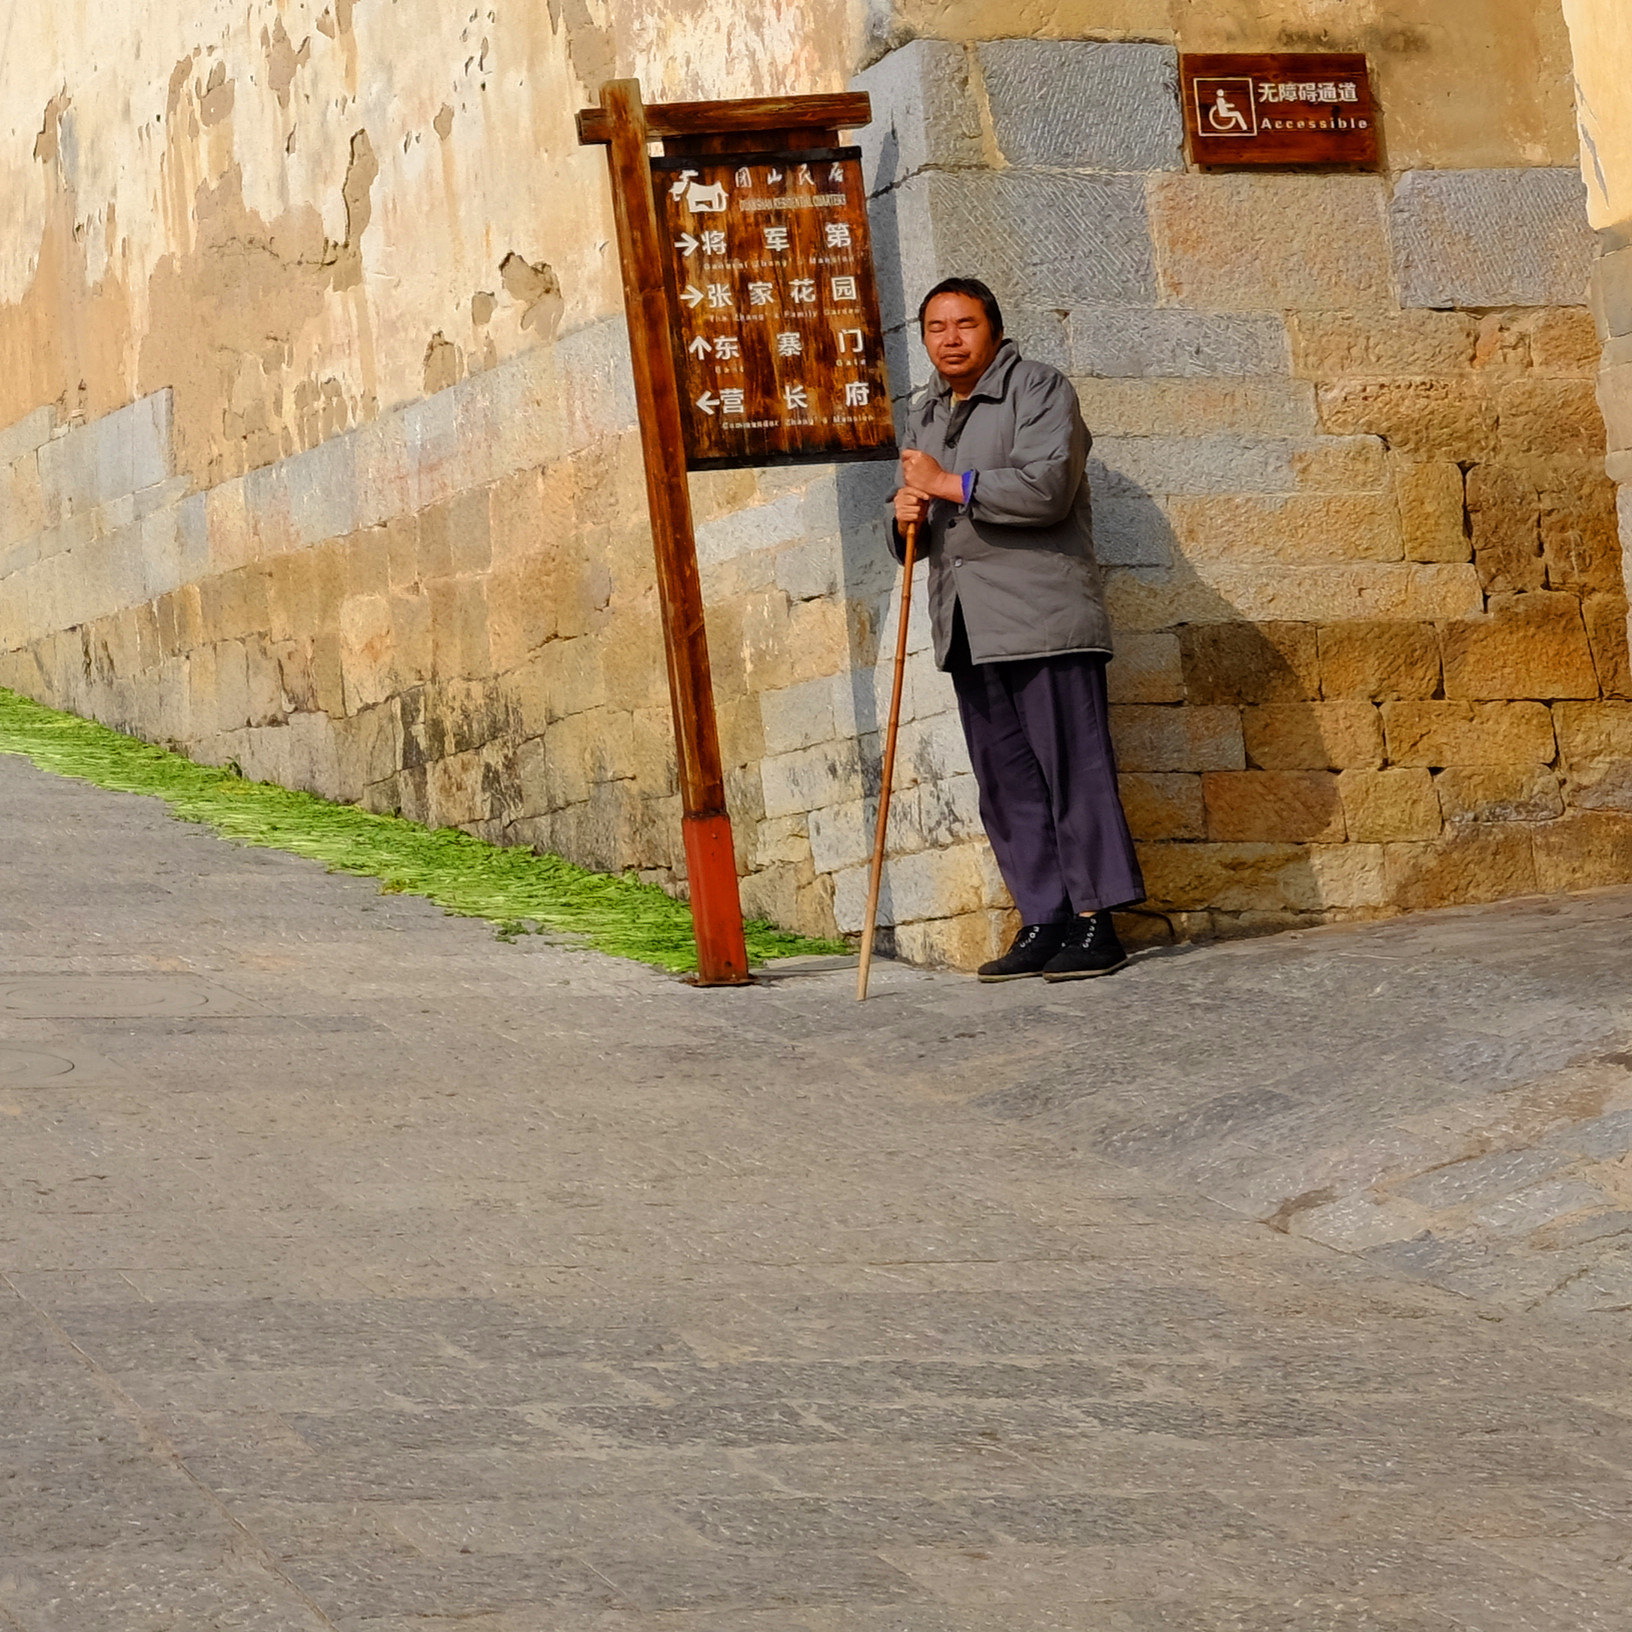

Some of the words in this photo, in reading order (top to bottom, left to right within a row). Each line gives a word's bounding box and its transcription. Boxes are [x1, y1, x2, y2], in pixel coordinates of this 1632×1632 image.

[1258, 82, 1359, 104] 无障碍通道
[1260, 117, 1368, 130] Accessible
[701, 223, 852, 256] 将军第
[809, 254, 855, 265] Mansion
[706, 275, 857, 309] 张家花园
[710, 314, 728, 323] The
[783, 309, 818, 319] Family
[823, 307, 861, 317] Garden
[712, 328, 864, 361] 东寨门
[835, 357, 867, 367] Gate
[719, 380, 870, 415] 营长府
[722, 418, 780, 430] Commander
[832, 412, 875, 424] Mansion
